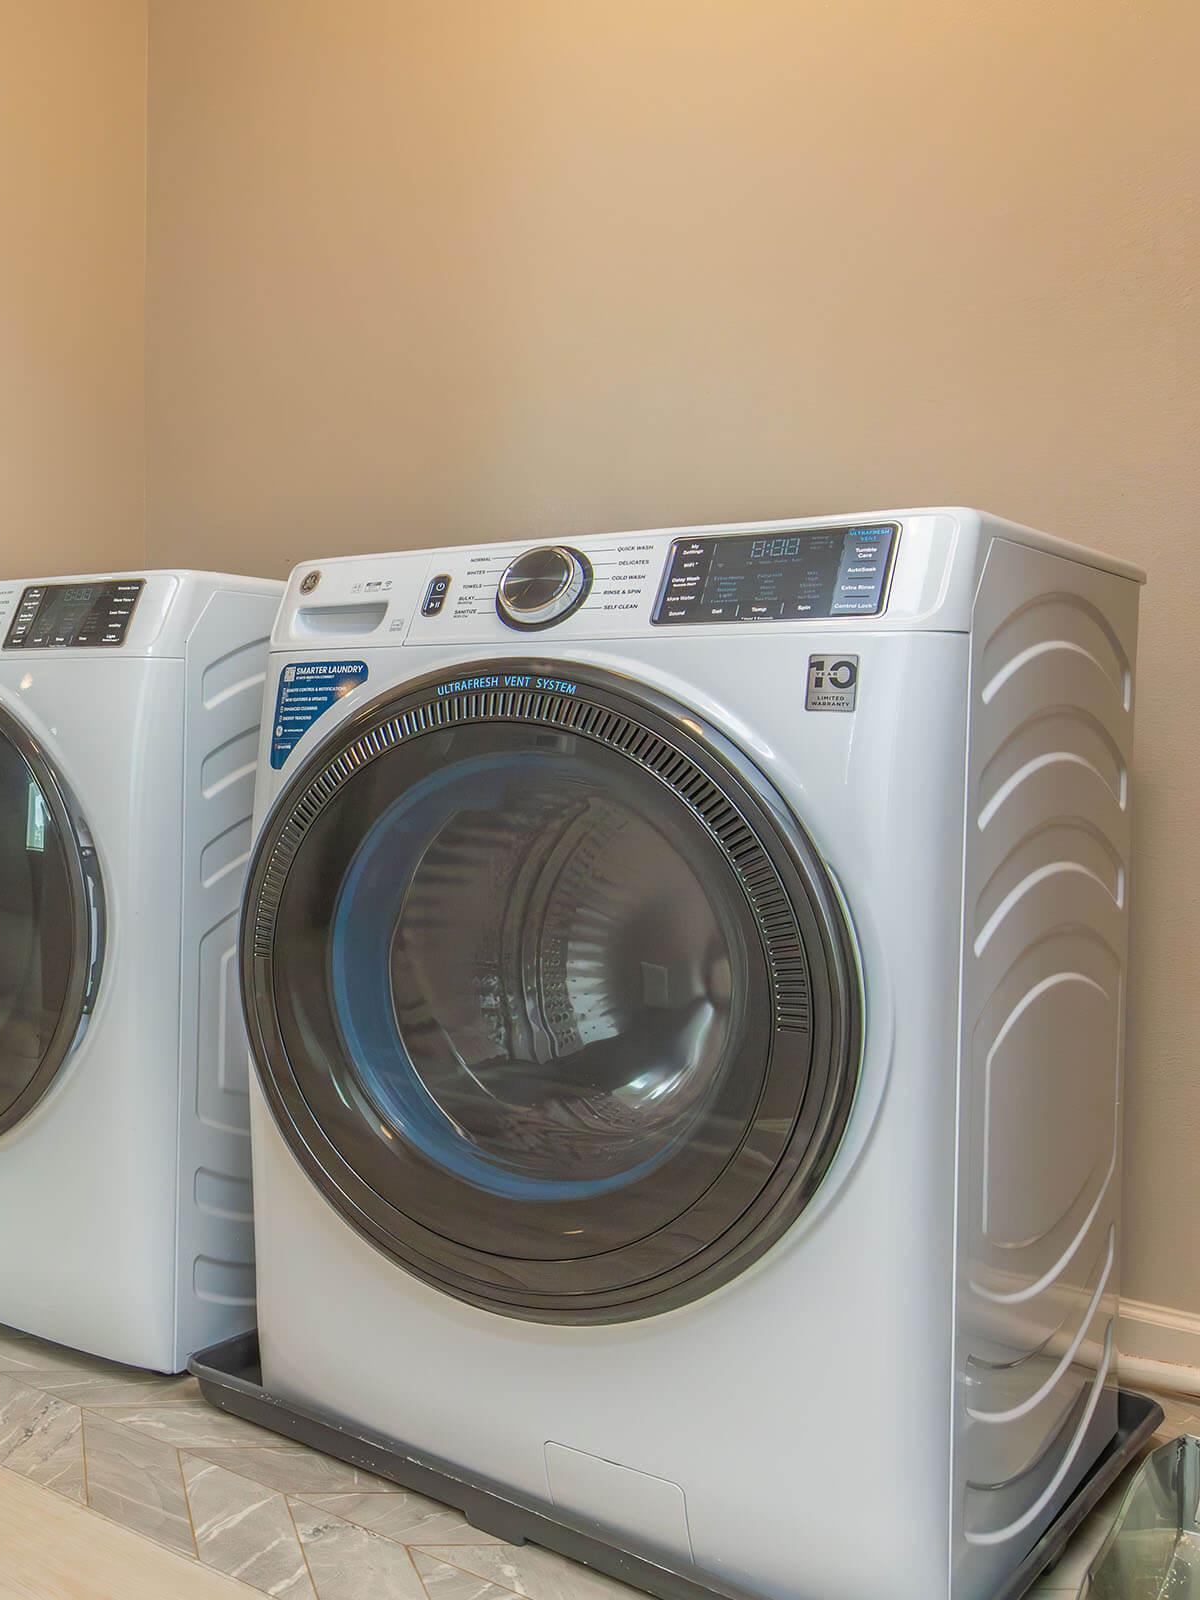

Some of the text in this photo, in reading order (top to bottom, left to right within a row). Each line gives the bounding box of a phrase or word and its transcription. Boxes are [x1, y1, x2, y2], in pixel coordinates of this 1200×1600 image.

[296, 665, 364, 675] SMARTER LAUNDRY
[810, 661, 857, 689] 10
[437, 675, 577, 696] ULTRAFRESH VENT SYSTEM
